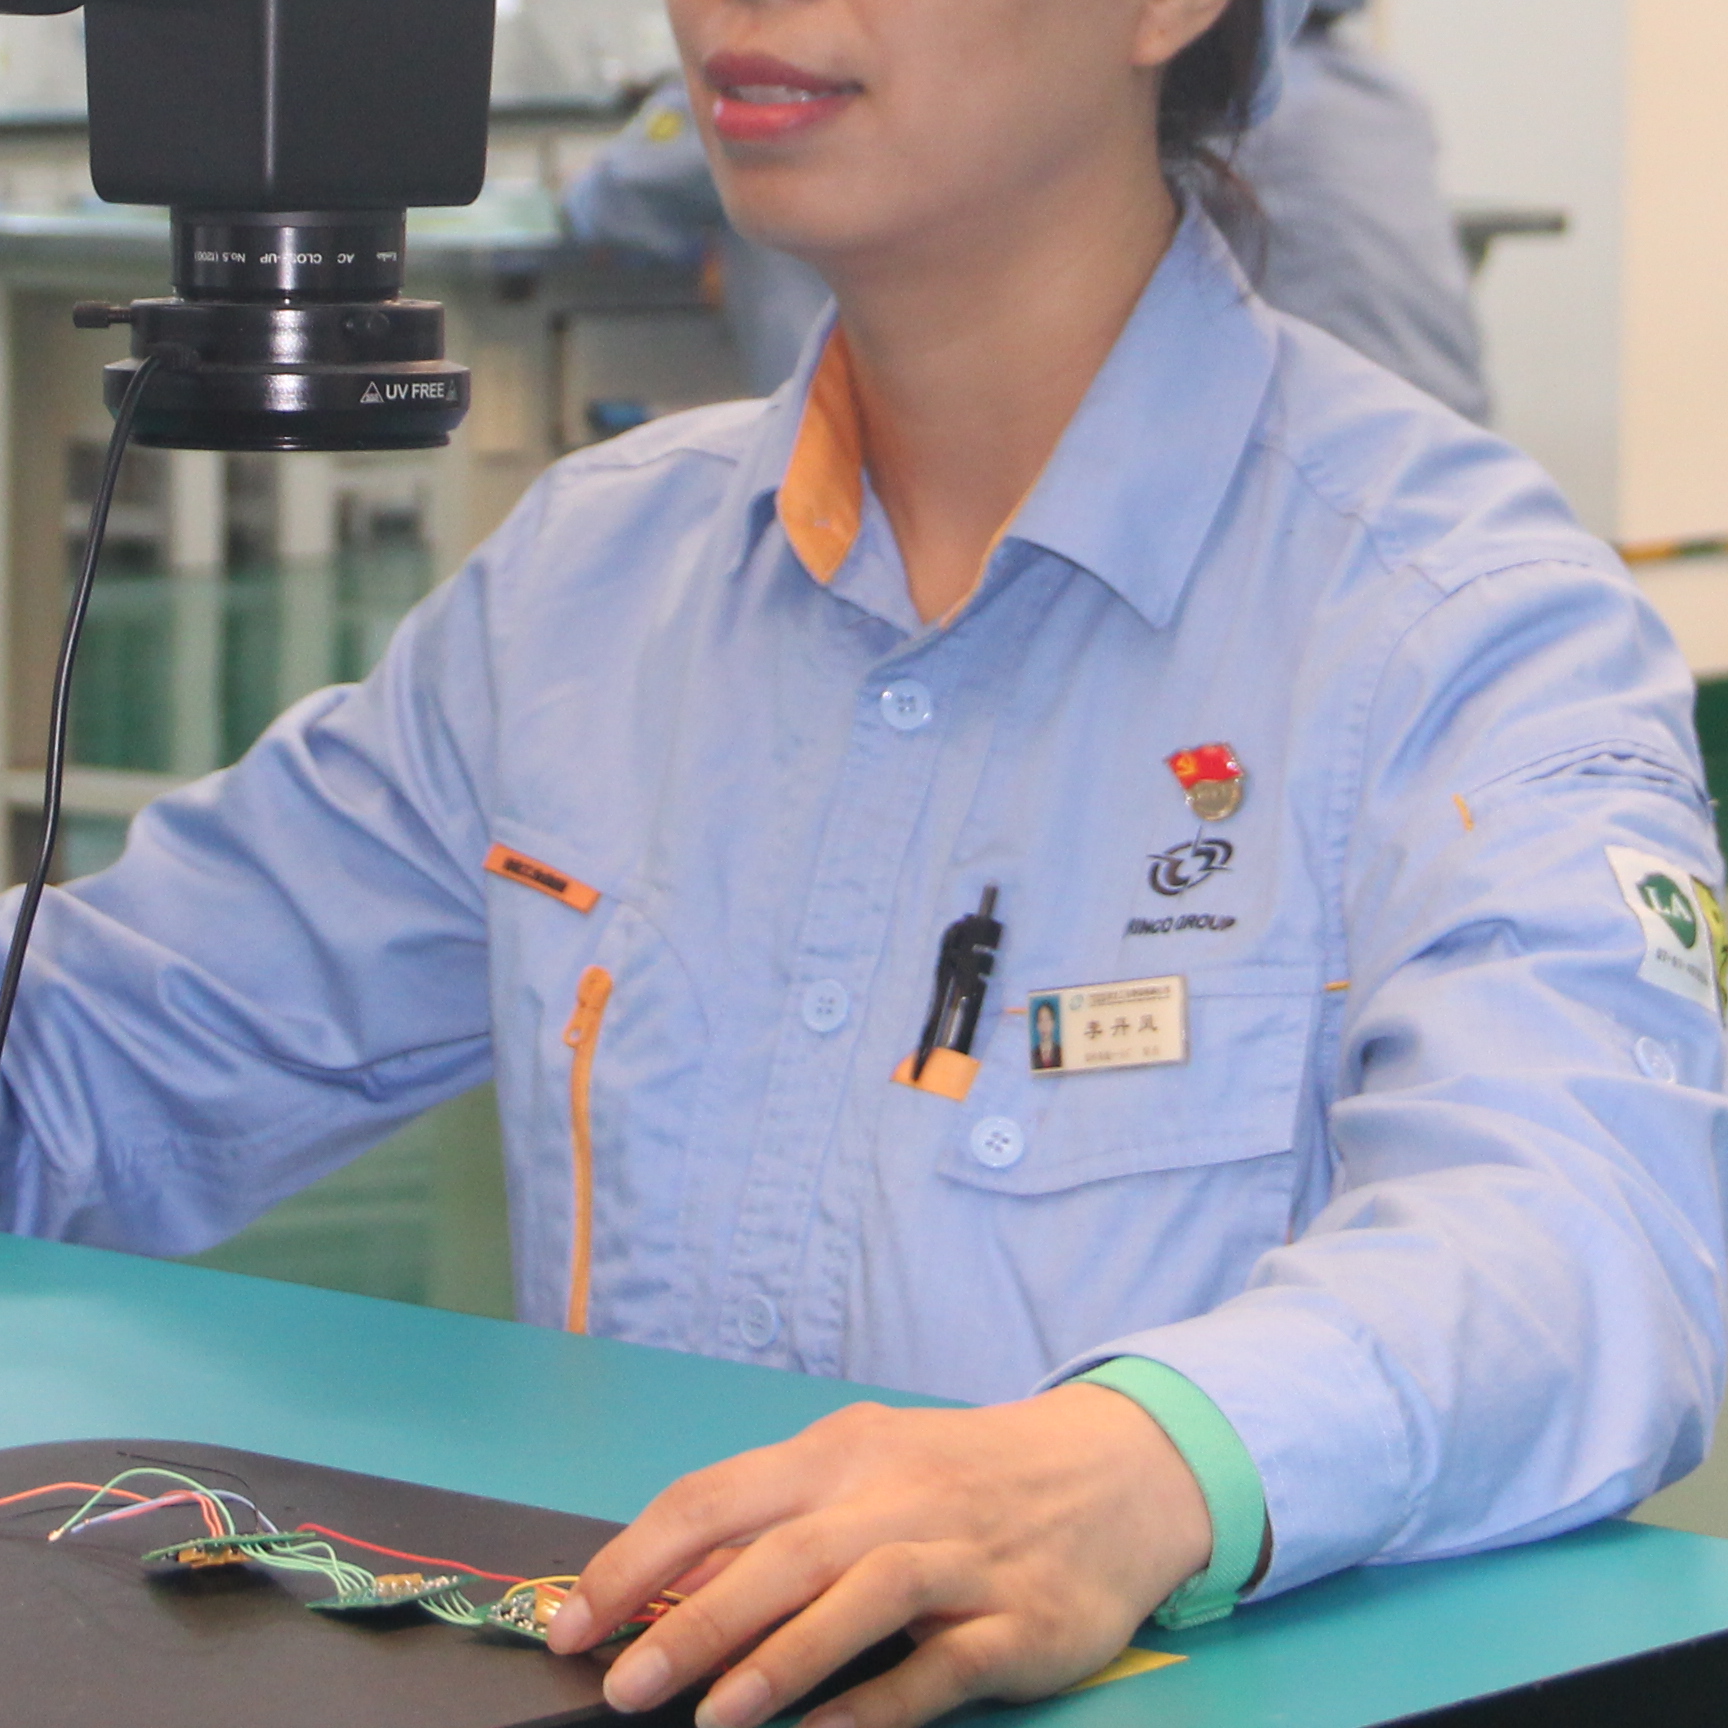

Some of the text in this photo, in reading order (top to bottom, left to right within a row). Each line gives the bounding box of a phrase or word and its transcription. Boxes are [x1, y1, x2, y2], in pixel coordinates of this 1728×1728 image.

[260, 252, 322, 264] CLO-UP
[337, 252, 354, 263] AC
[385, 382, 445, 400] UV FREE
[1175, 913, 1236, 931] GROUP
